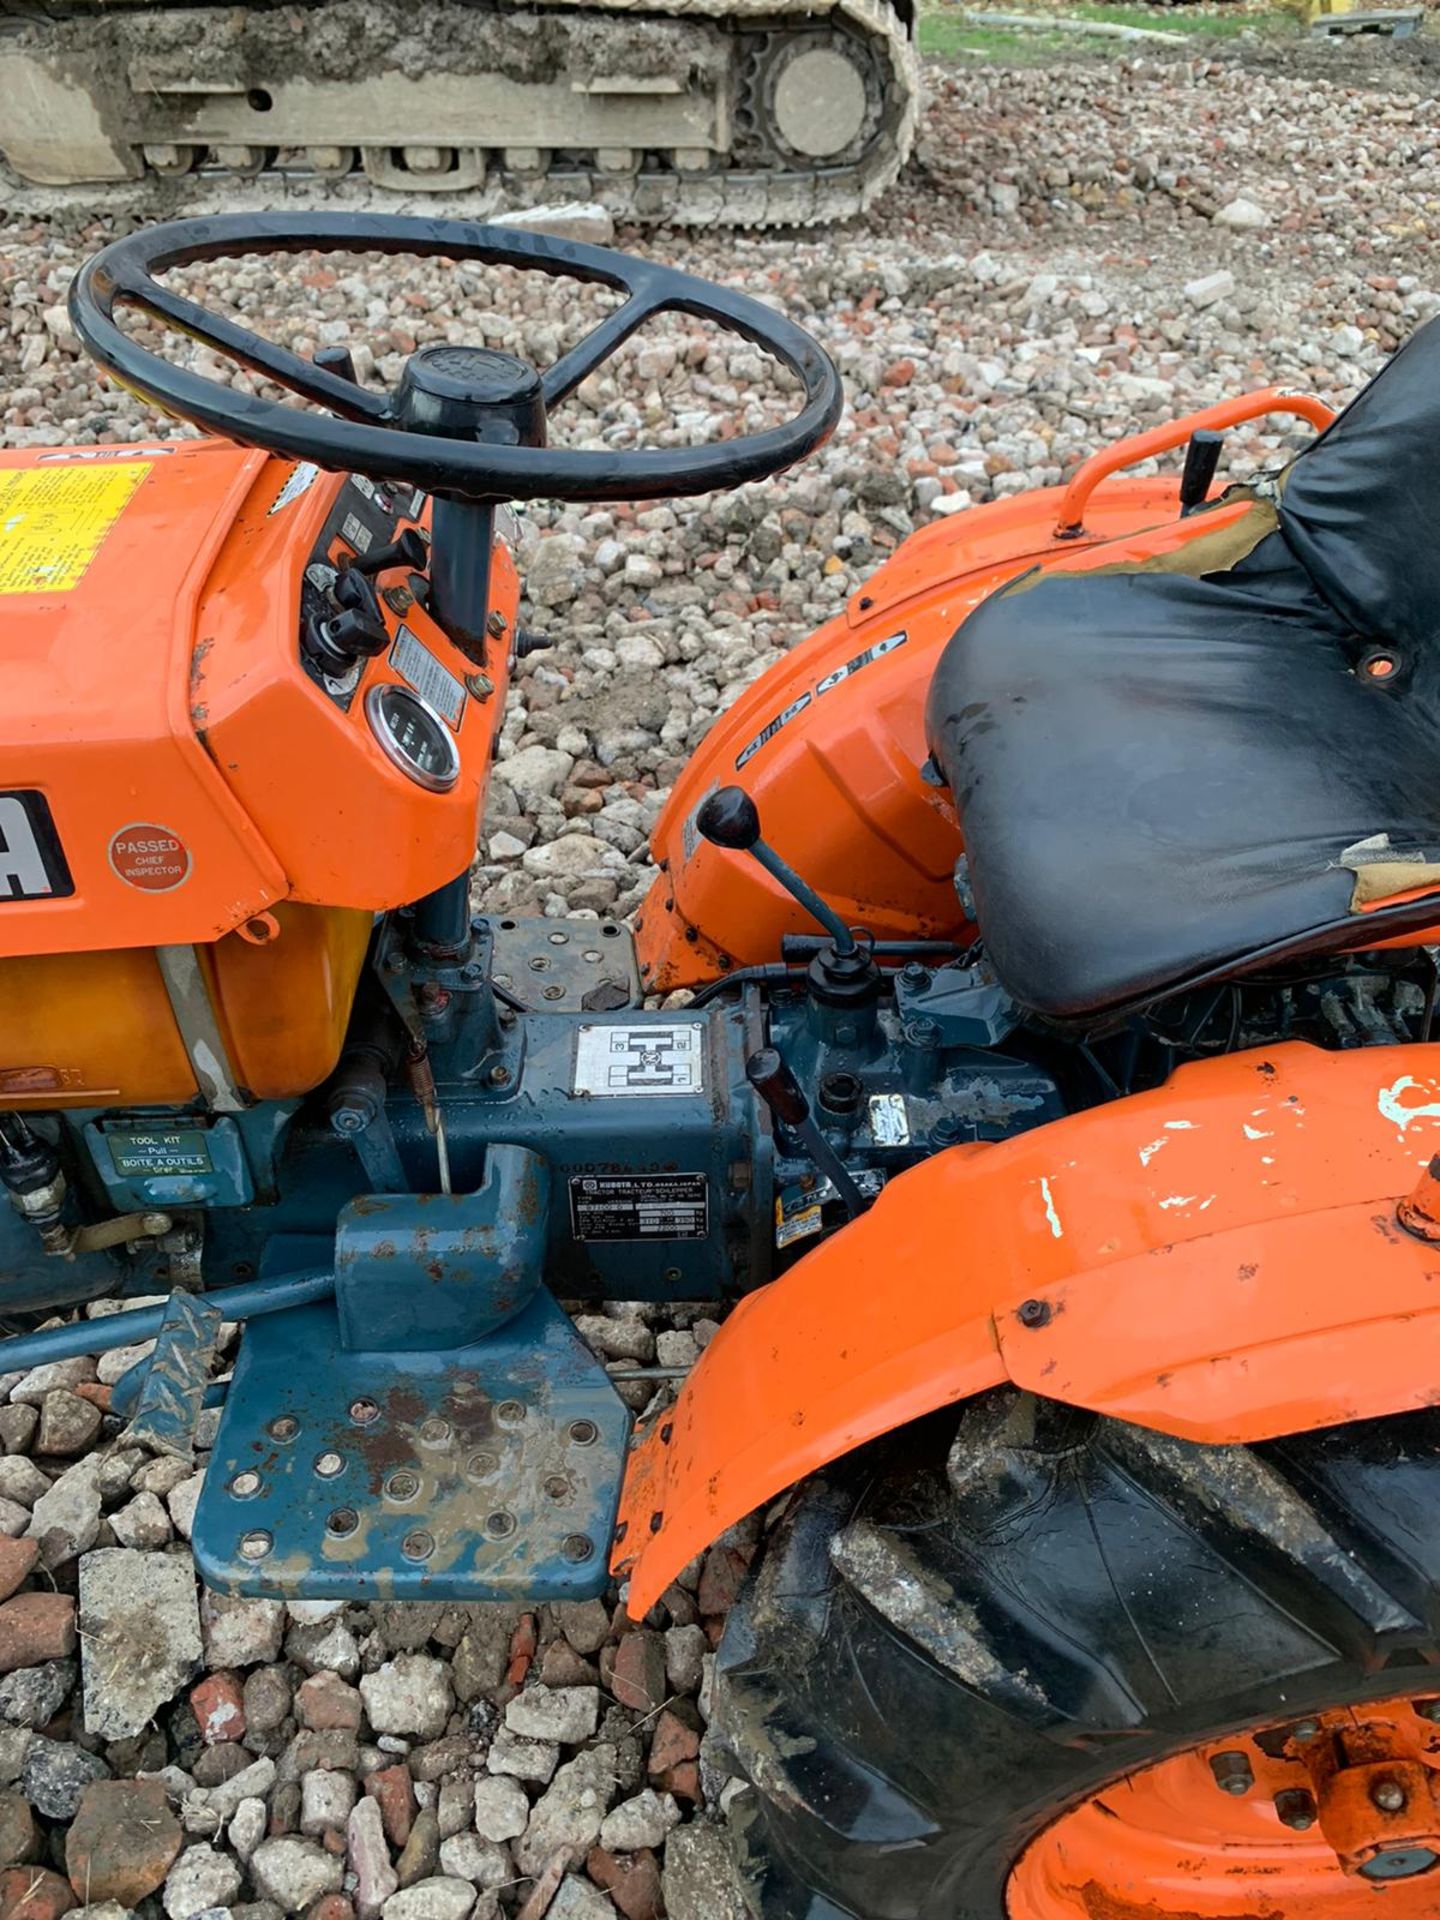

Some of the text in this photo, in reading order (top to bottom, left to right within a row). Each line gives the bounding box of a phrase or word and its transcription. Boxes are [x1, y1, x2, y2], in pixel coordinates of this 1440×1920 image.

[115, 839, 180, 855] PASSED
[135, 856, 165, 866] CHIEF
[124, 865, 182, 877] INSPECTOR
[129, 1135, 181, 1145] TOOL KIT
[166, 1157, 204, 1166] OUTILS
